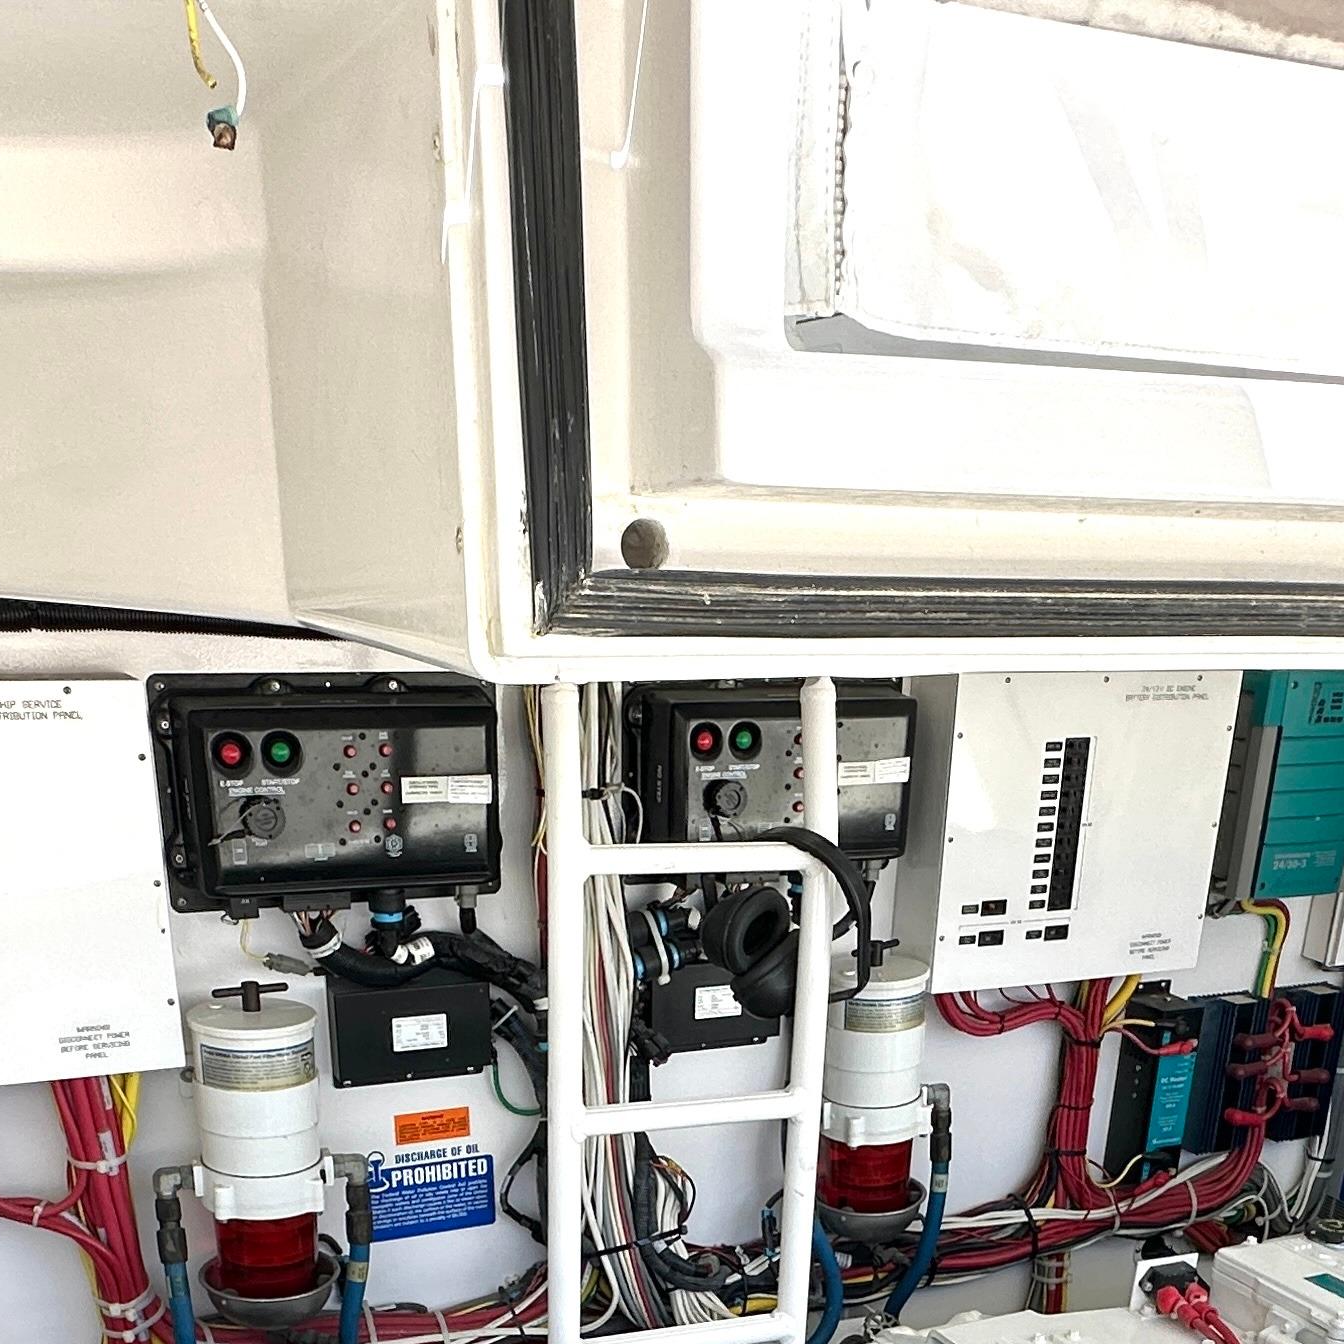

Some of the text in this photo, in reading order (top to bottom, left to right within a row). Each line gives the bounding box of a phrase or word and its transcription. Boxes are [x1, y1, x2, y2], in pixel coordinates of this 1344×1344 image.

[22, 700, 62, 709] SERVICE
[395, 1144, 480, 1164] DISCHARGE OF OIL
[391, 1158, 488, 1188] PROHIBITED
